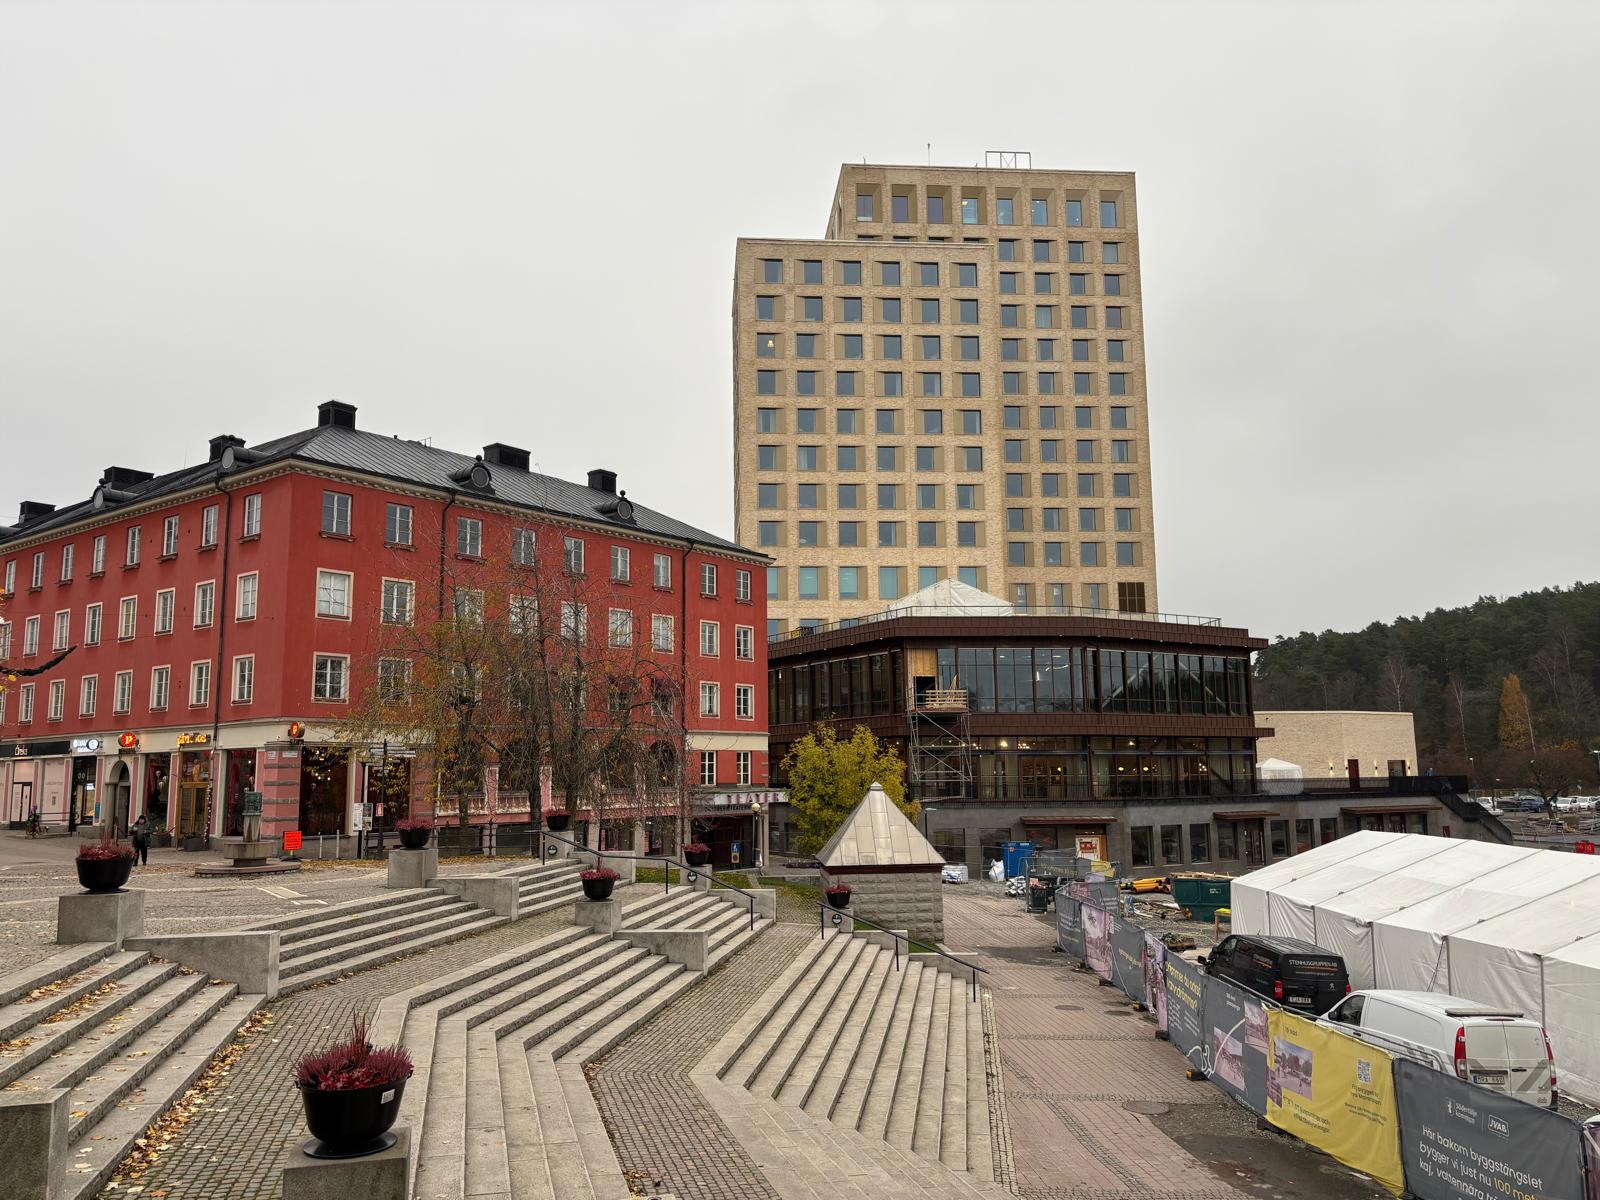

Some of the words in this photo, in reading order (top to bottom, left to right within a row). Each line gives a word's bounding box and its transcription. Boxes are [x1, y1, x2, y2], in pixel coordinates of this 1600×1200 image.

[726, 791, 780, 804] TEATER
[1490, 1119, 1507, 1133] JVAB
[1419, 1156, 1434, 1177] kaj,
[1436, 1167, 1484, 1200] vattennära
[1420, 1140, 1450, 1165] bygger
[1450, 1158, 1459, 1171] vi
[1460, 1160, 1477, 1180] just
[1479, 1173, 1492, 1187] nu
[1494, 1177, 1511, 1195] 100
[1422, 1124, 1436, 1141] Här
[1437, 1131, 1469, 1157] bakom
[1470, 1147, 1543, 1191] byggstängslet
